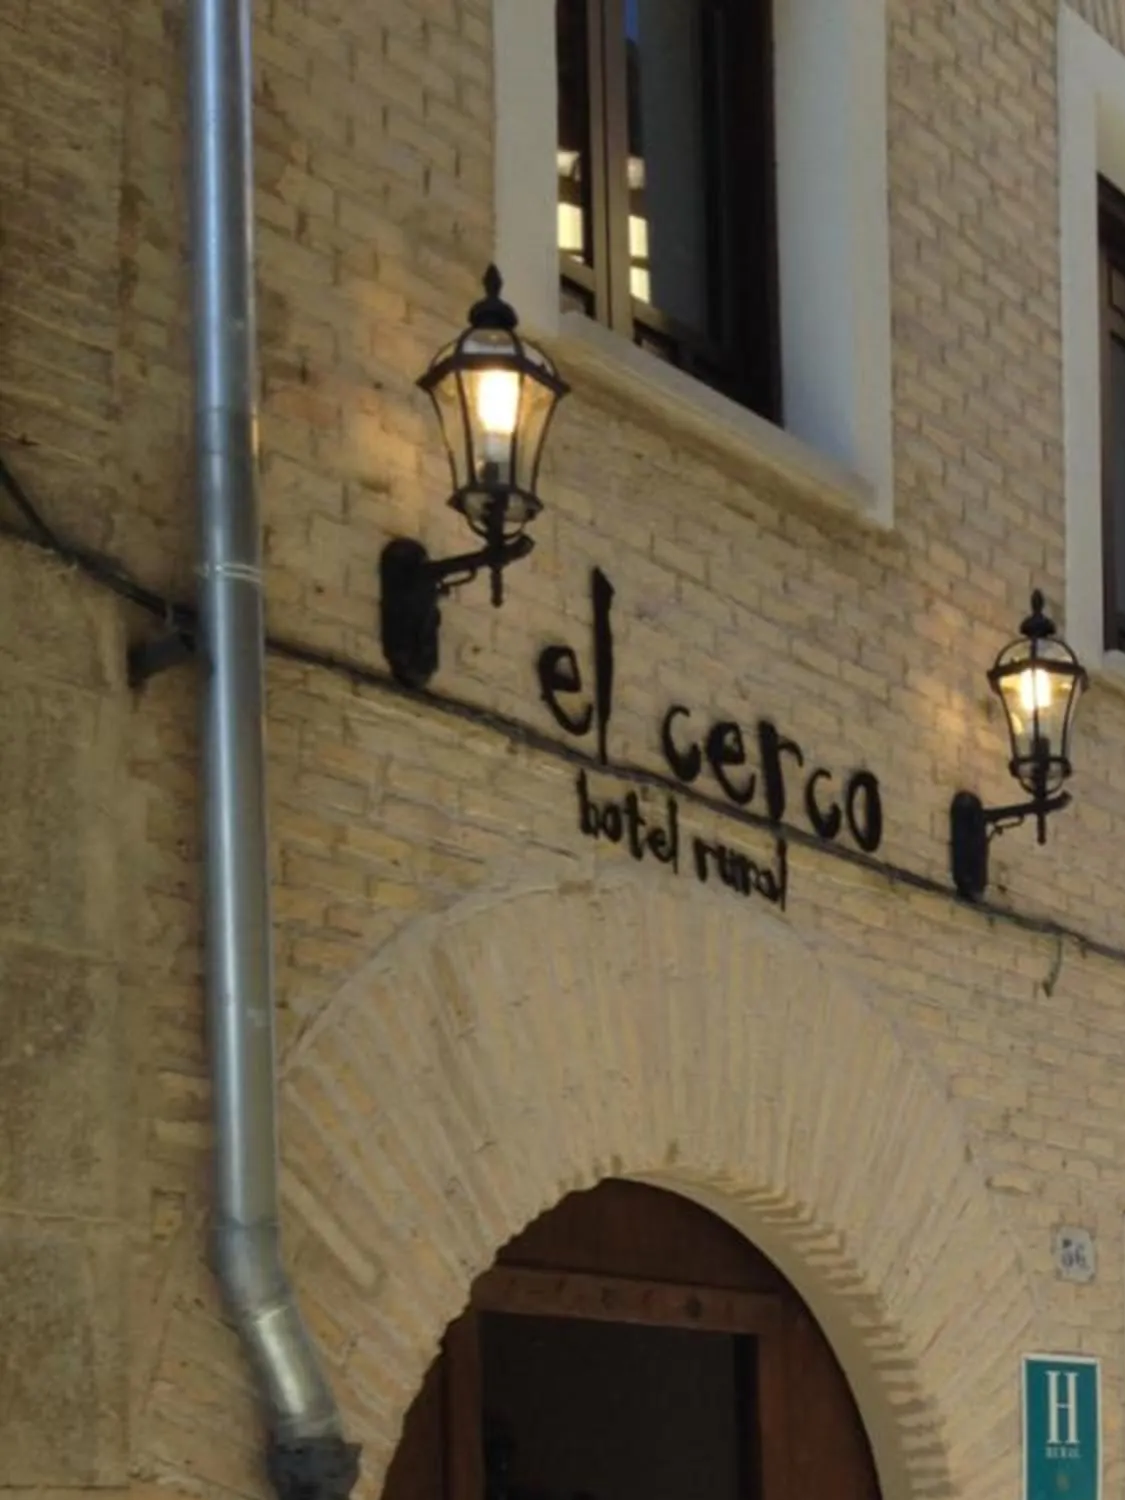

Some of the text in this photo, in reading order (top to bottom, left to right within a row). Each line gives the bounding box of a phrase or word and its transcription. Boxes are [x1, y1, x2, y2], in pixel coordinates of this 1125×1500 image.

[536, 566, 881, 852] el cerco
[576, 769, 787, 911] hotel rural
[1045, 1370, 1080, 1444] H
